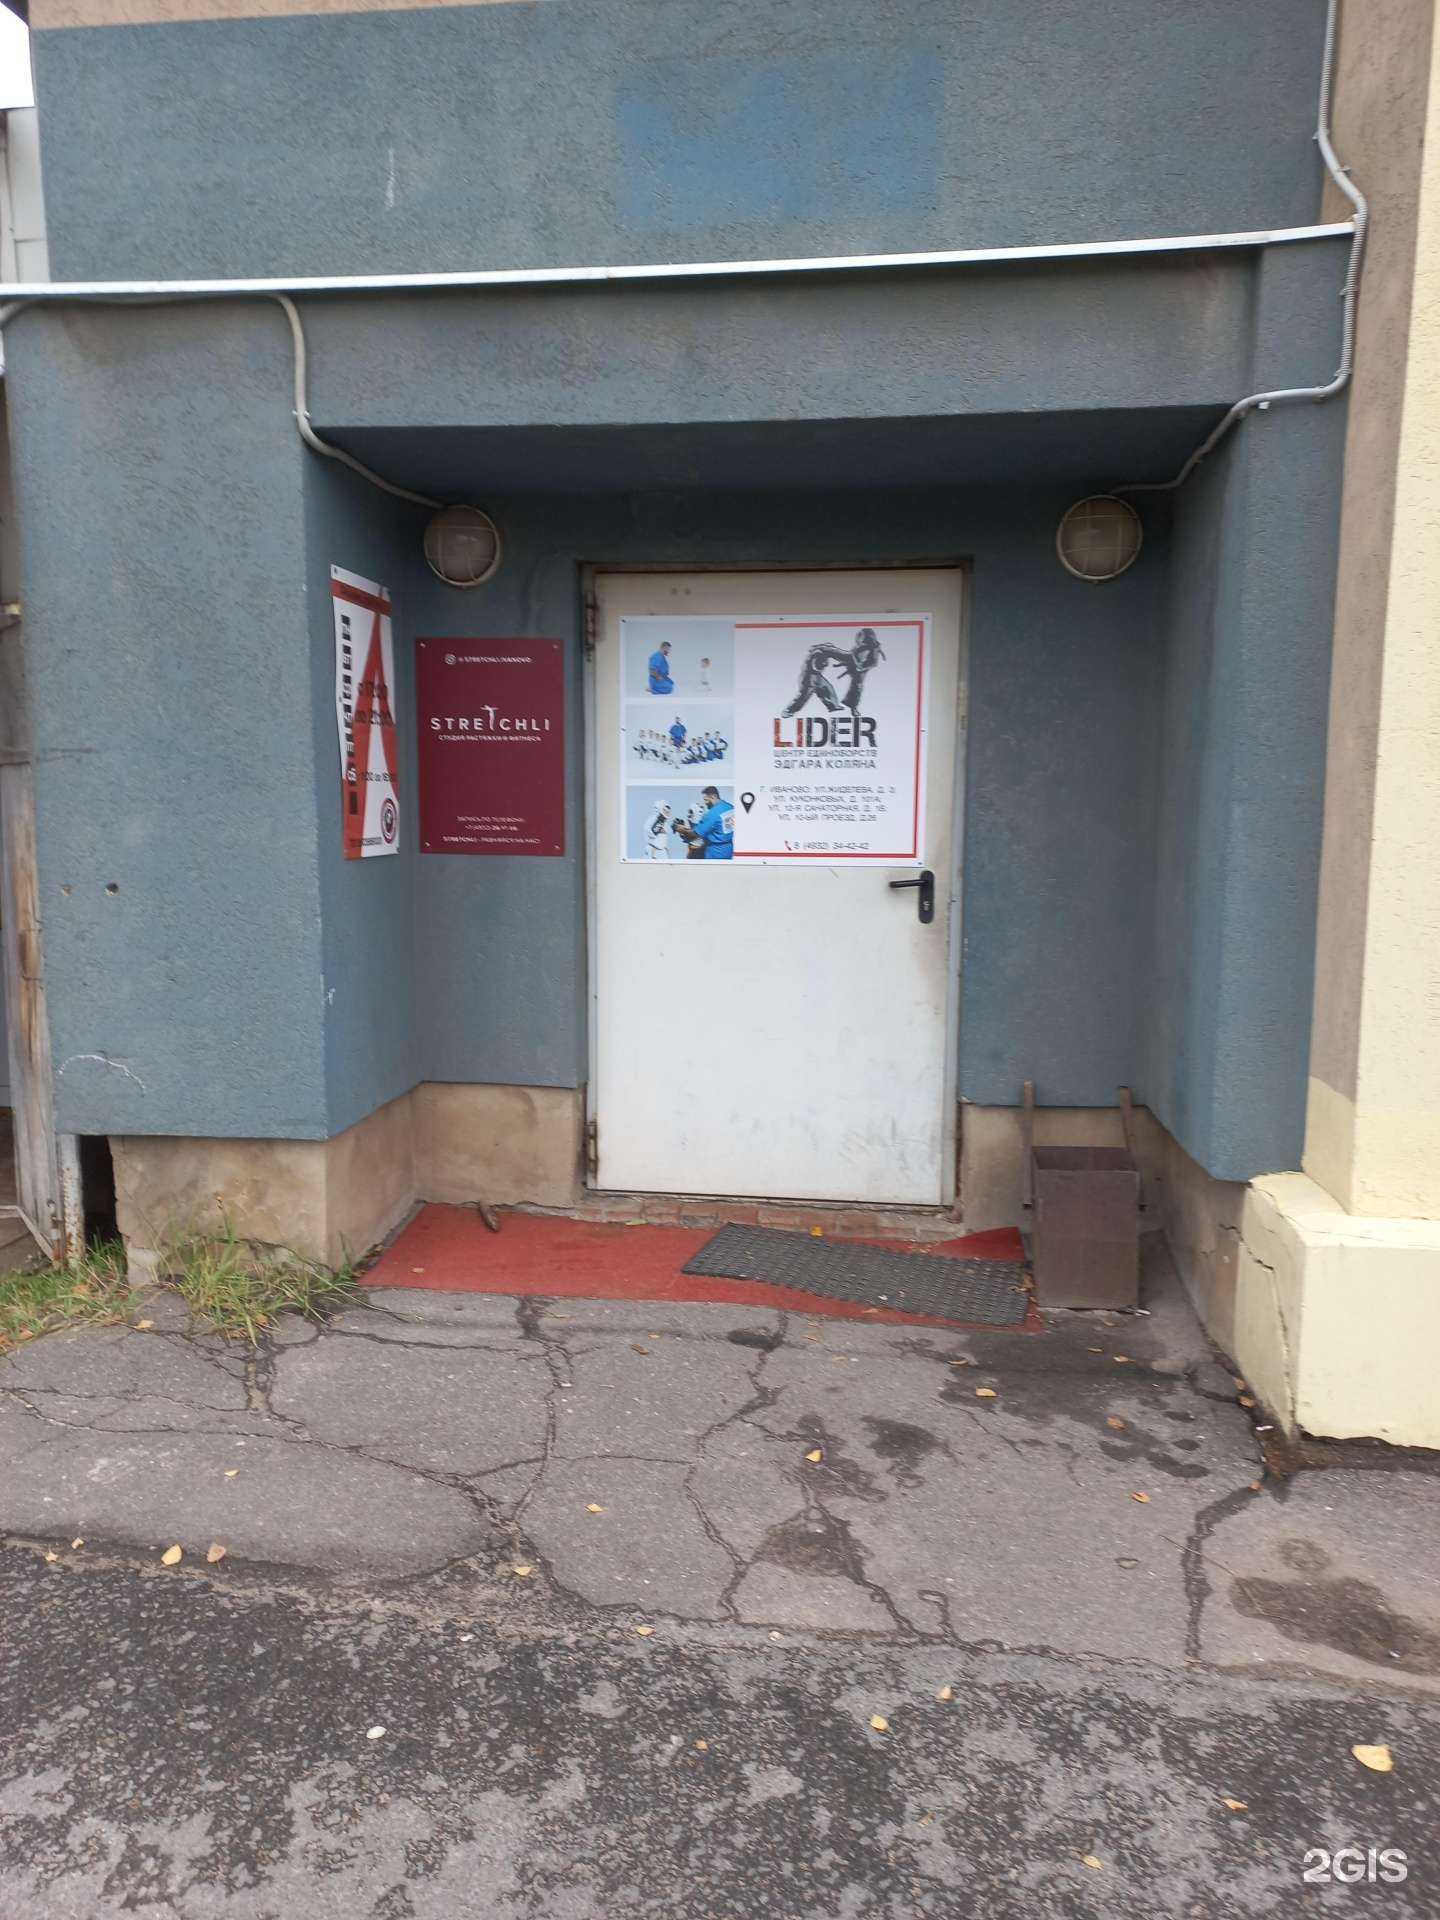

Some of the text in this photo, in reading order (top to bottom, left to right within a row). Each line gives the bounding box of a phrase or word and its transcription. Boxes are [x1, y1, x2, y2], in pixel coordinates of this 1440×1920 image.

[430, 704, 550, 731] STRETCHLI
[773, 717, 877, 748] LIDER
[773, 749, 878, 758] ЦЕНТР ЕДИНОБОРСТВ
[773, 759, 877, 769] ЭДГАРА КОЛЯНА
